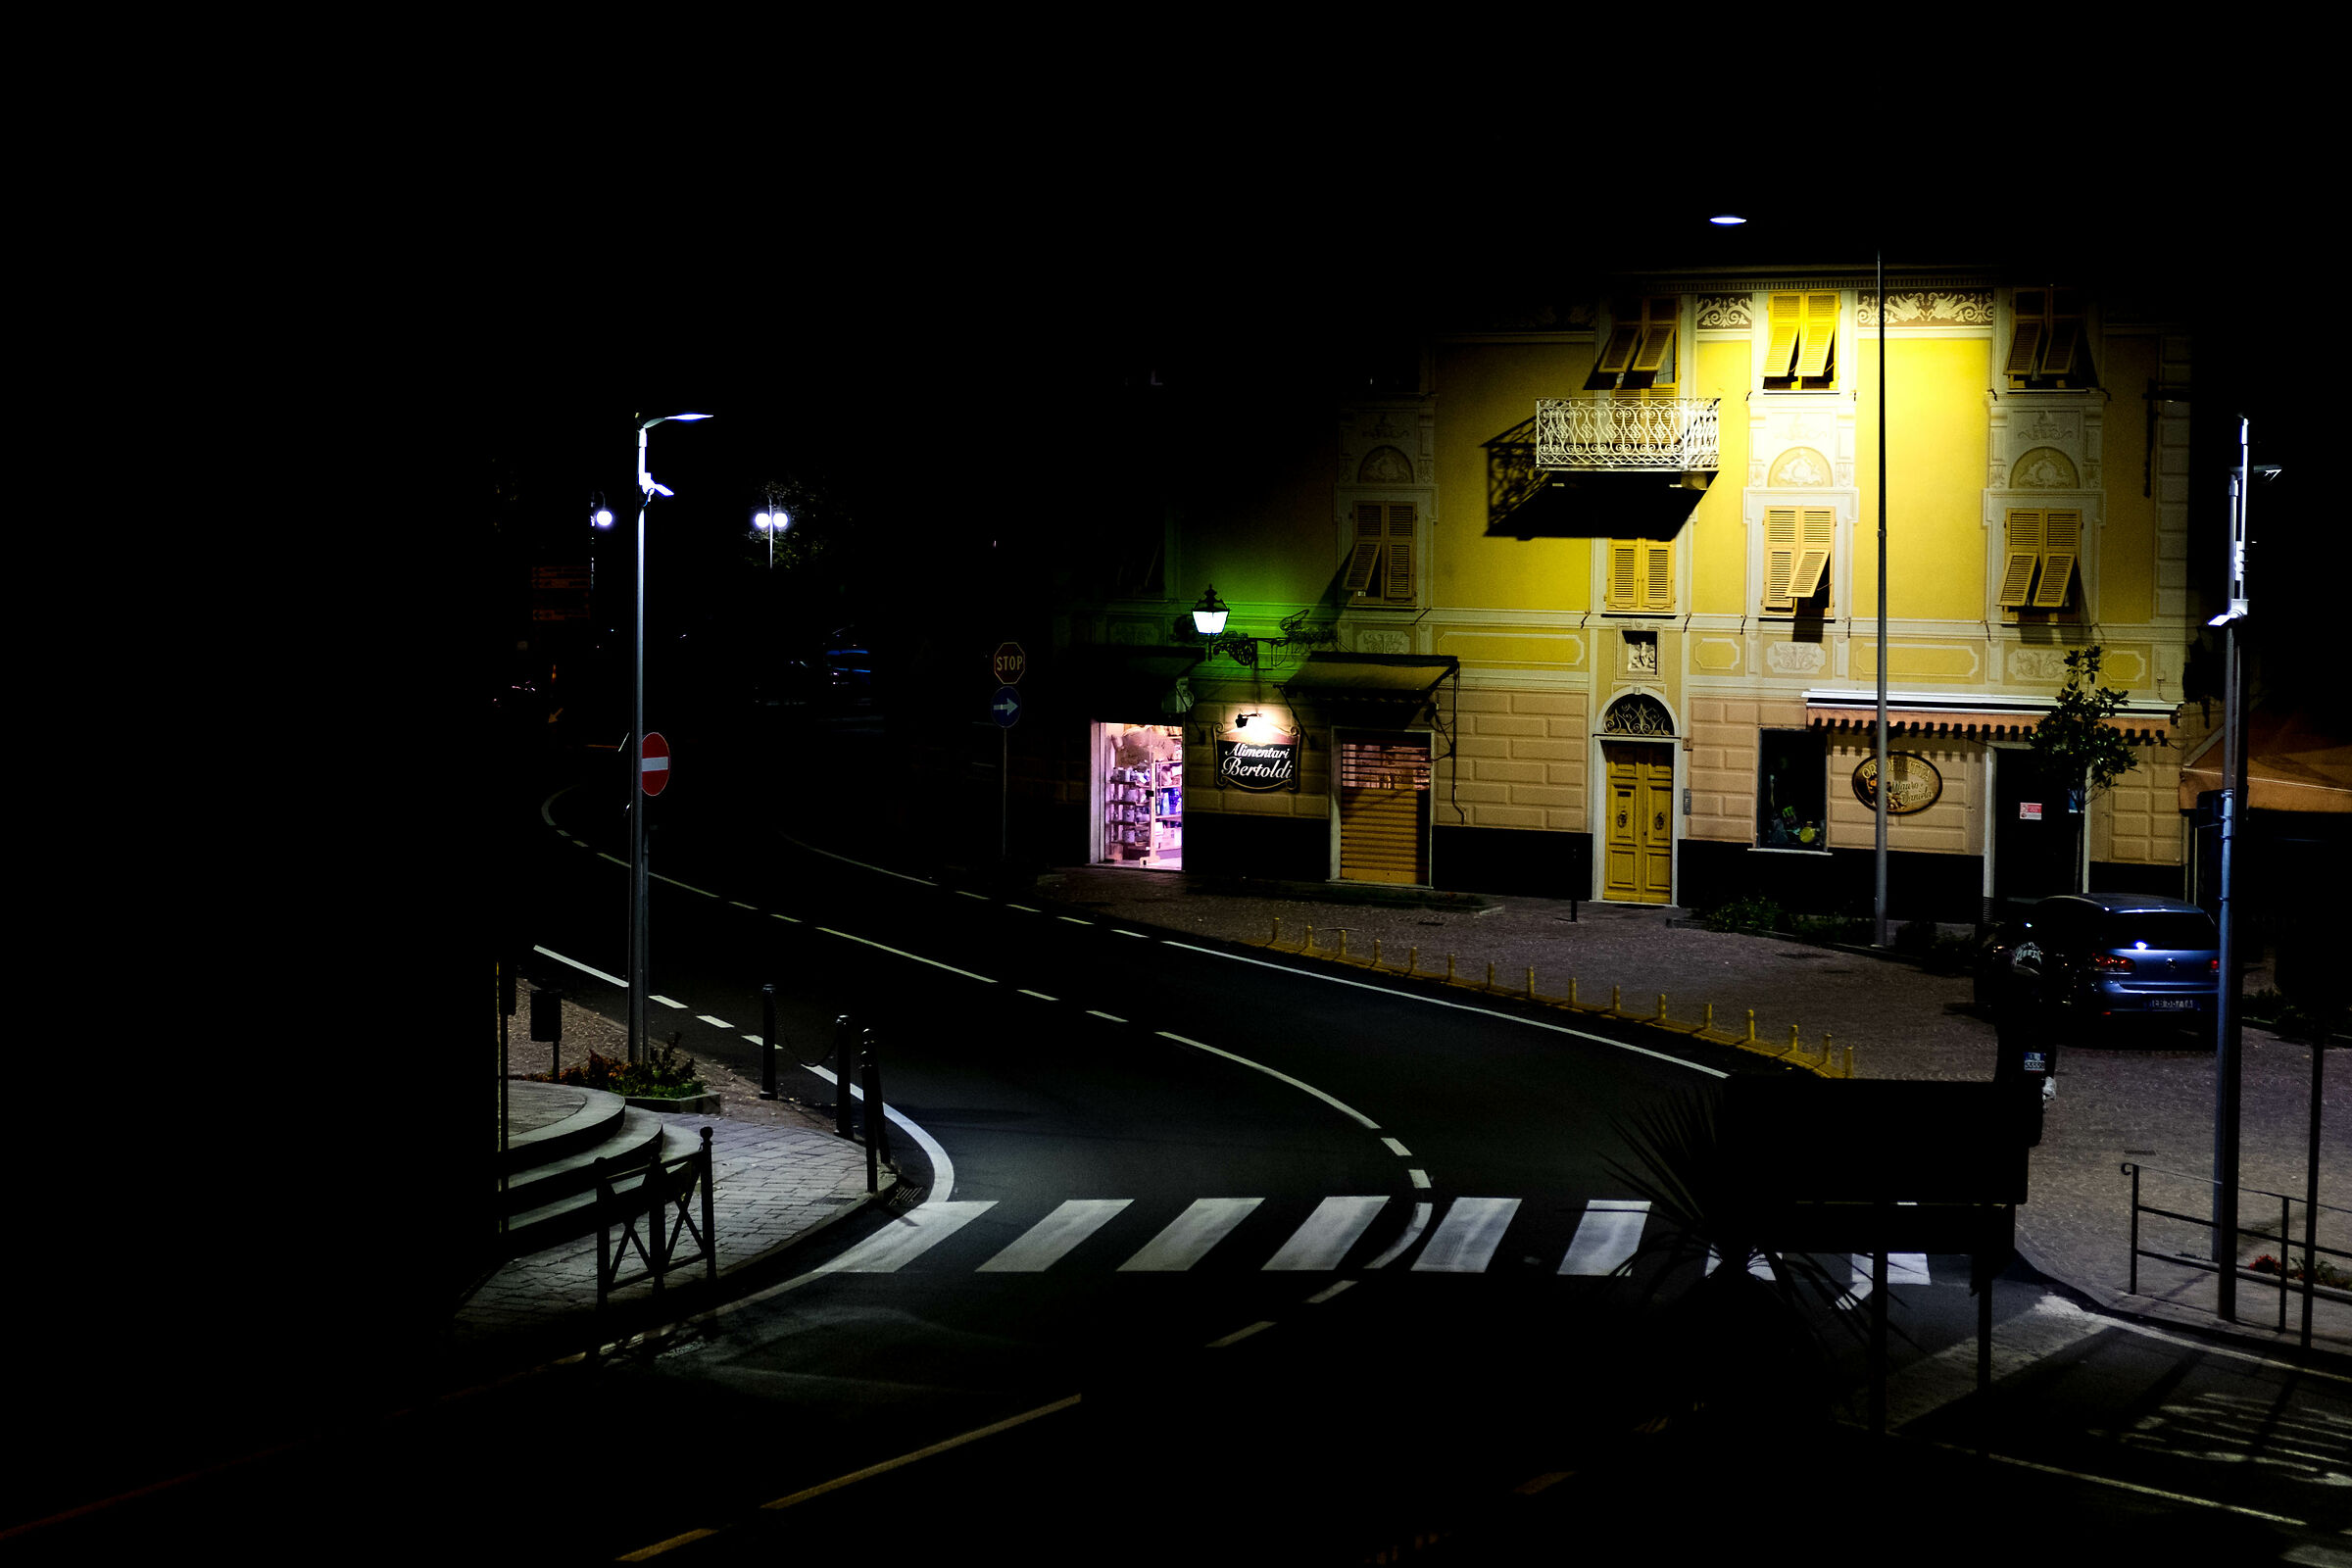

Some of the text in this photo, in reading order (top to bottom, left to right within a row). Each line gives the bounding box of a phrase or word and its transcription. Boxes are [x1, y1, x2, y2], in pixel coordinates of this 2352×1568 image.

[996, 655, 1023, 672] STOP
[1224, 742, 1291, 760] Alimentari
[1221, 756, 1294, 779] Bertoldi
